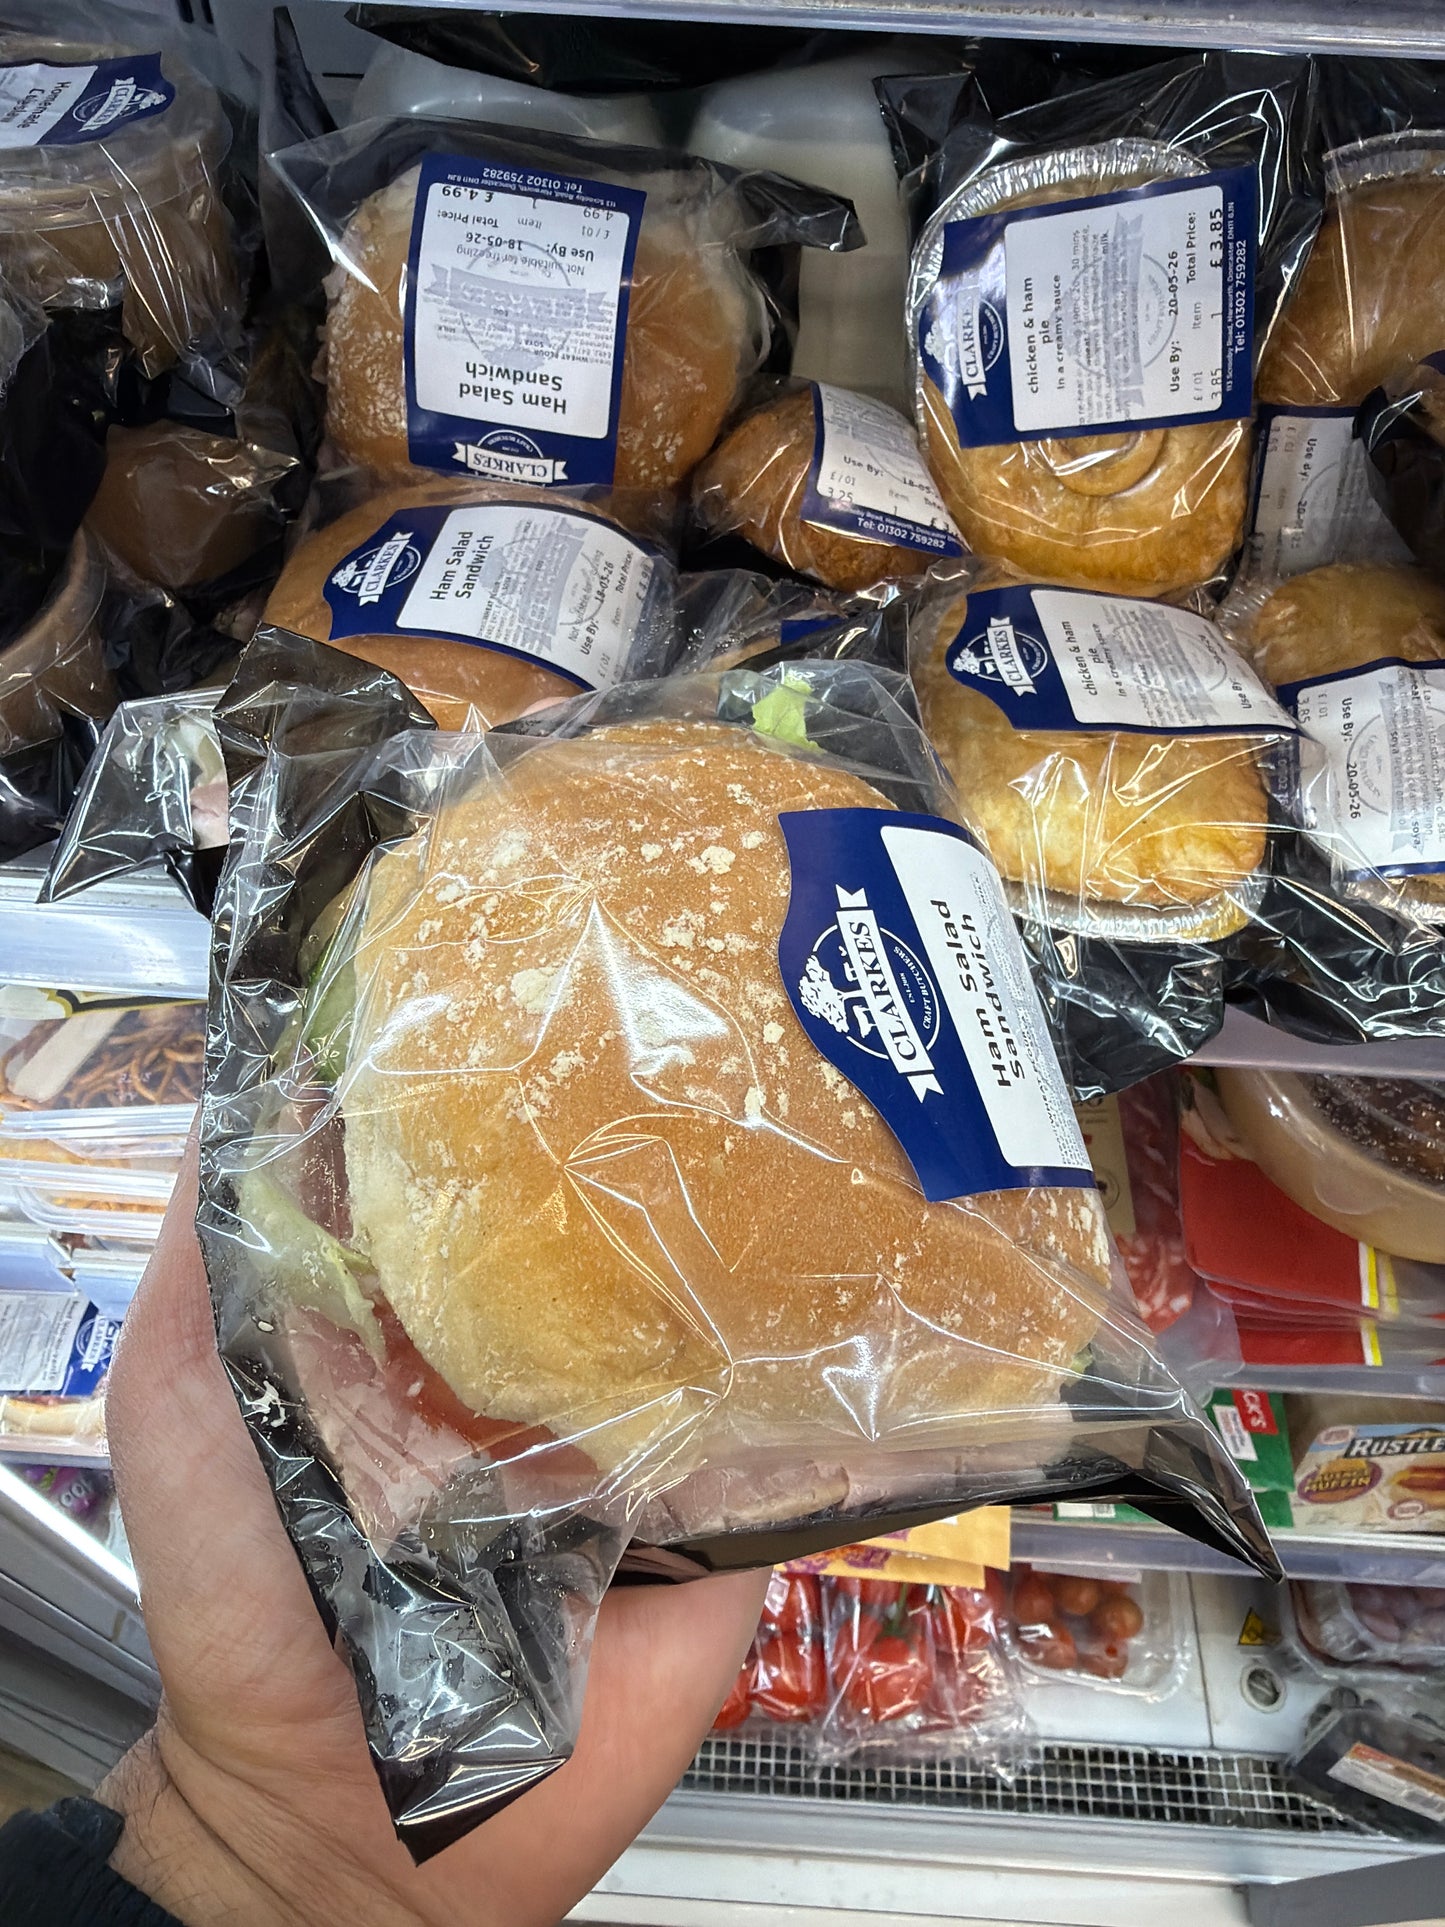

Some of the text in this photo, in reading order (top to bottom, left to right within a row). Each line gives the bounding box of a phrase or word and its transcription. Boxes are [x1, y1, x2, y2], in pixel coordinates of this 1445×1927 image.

[17, 81, 71, 129] Homemade
[442, 185, 478, 201] 4.99
[483, 167, 583, 194] Tel: 01302 759282
[484, 191, 494, 203] £
[437, 209, 469, 224] Price:
[472, 215, 499, 228] Total
[581, 226, 594, 237] 01
[1187, 212, 1197, 248] Price:
[1210, 207, 1223, 252] 3.85
[456, 244, 501, 263] freezing
[465, 232, 594, 262] Use By: 18-05-26
[522, 255, 564, 271] suitable
[568, 265, 585, 276] Not
[1187, 252, 1197, 284] Total
[1210, 258, 1222, 269] £
[1052, 274, 1062, 312] sauce
[1234, 239, 1248, 354] Tel: 01302 759282
[1022, 277, 1039, 395] chicken & ham
[1039, 319, 1053, 345] pie
[1168, 250, 1182, 393] Use By: 20-05-26
[962, 300, 979, 379] CLARKE
[1054, 316, 1065, 363] creamy
[466, 362, 563, 391] Sandwich
[1058, 366, 1065, 374] a
[1193, 371, 1203, 385] 01
[459, 383, 567, 415] Ham Salad
[1304, 438, 1317, 459] Use
[473, 453, 547, 477] CLARKES
[843, 455, 884, 478] Use By:
[844, 474, 856, 486] 01
[857, 517, 945, 549] Tel: 01302 759282
[365, 544, 400, 592] CLARKES
[430, 531, 474, 600] Ham Salad
[455, 535, 495, 599] Sandwich
[615, 573, 627, 595] Total
[581, 561, 615, 656] Use By: 18-05-26
[993, 630, 1023, 682] CLARKES
[1062, 621, 1098, 696] chicken & ham
[1088, 647, 1104, 664] pie
[1239, 692, 1252, 709] Use
[1318, 708, 1328, 719] 01
[1340, 697, 1361, 820] Use By: 20-05-26
[849, 921, 918, 1061] CLARKES
[893, 946, 931, 1030] CRAFT BUTCHERS
[930, 899, 1012, 1087] Ham Salad
[962, 913, 1025, 1080] Sandwich
[1304, 1477, 1371, 1493] MUFFIN
